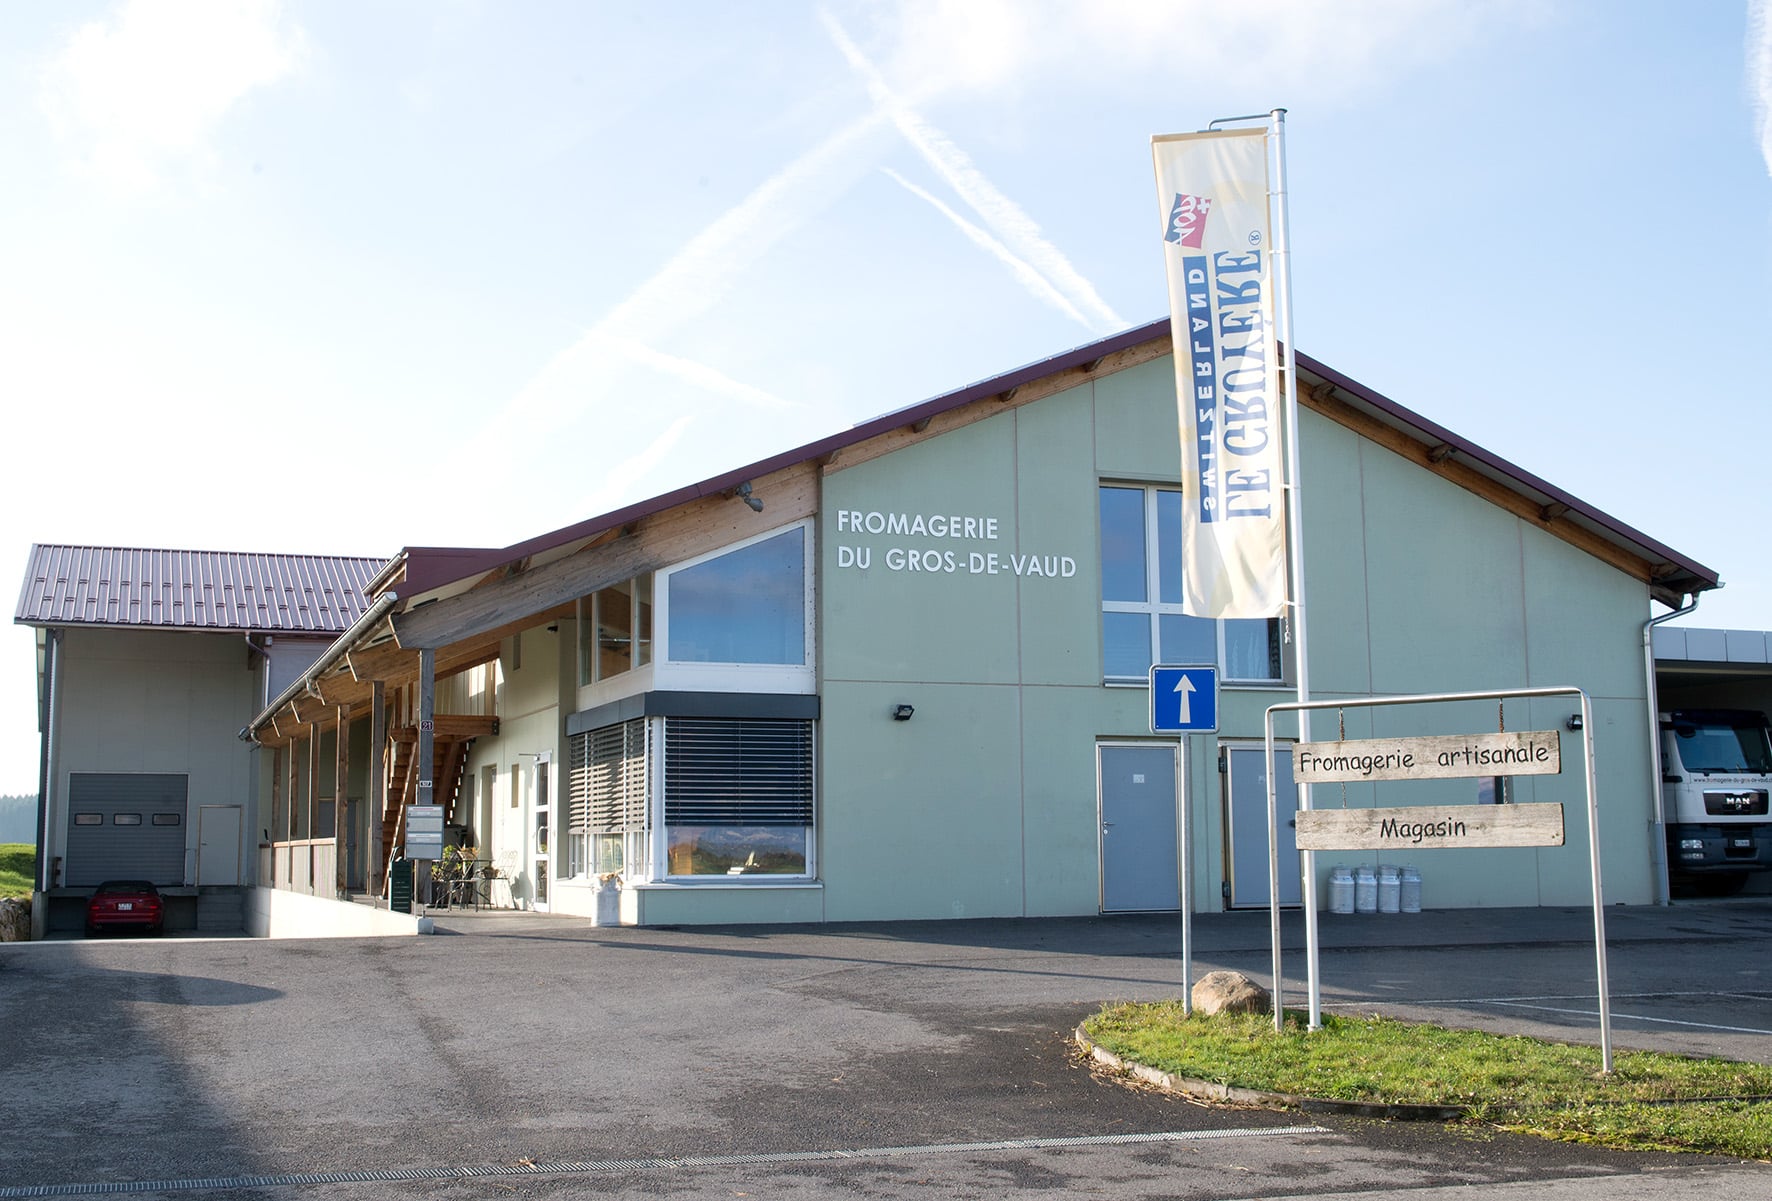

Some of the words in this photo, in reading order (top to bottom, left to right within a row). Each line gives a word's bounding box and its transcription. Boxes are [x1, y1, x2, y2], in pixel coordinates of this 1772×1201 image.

[837, 510, 998, 539] FROMAGERIE
[837, 546, 870, 569] DU
[885, 548, 1076, 577] GROS-DE-VAUD
[1300, 749, 1415, 775] Fromagerie
[1437, 741, 1549, 766] artisanale
[1726, 797, 1750, 805] MAN
[1380, 817, 1466, 843] Magasin
